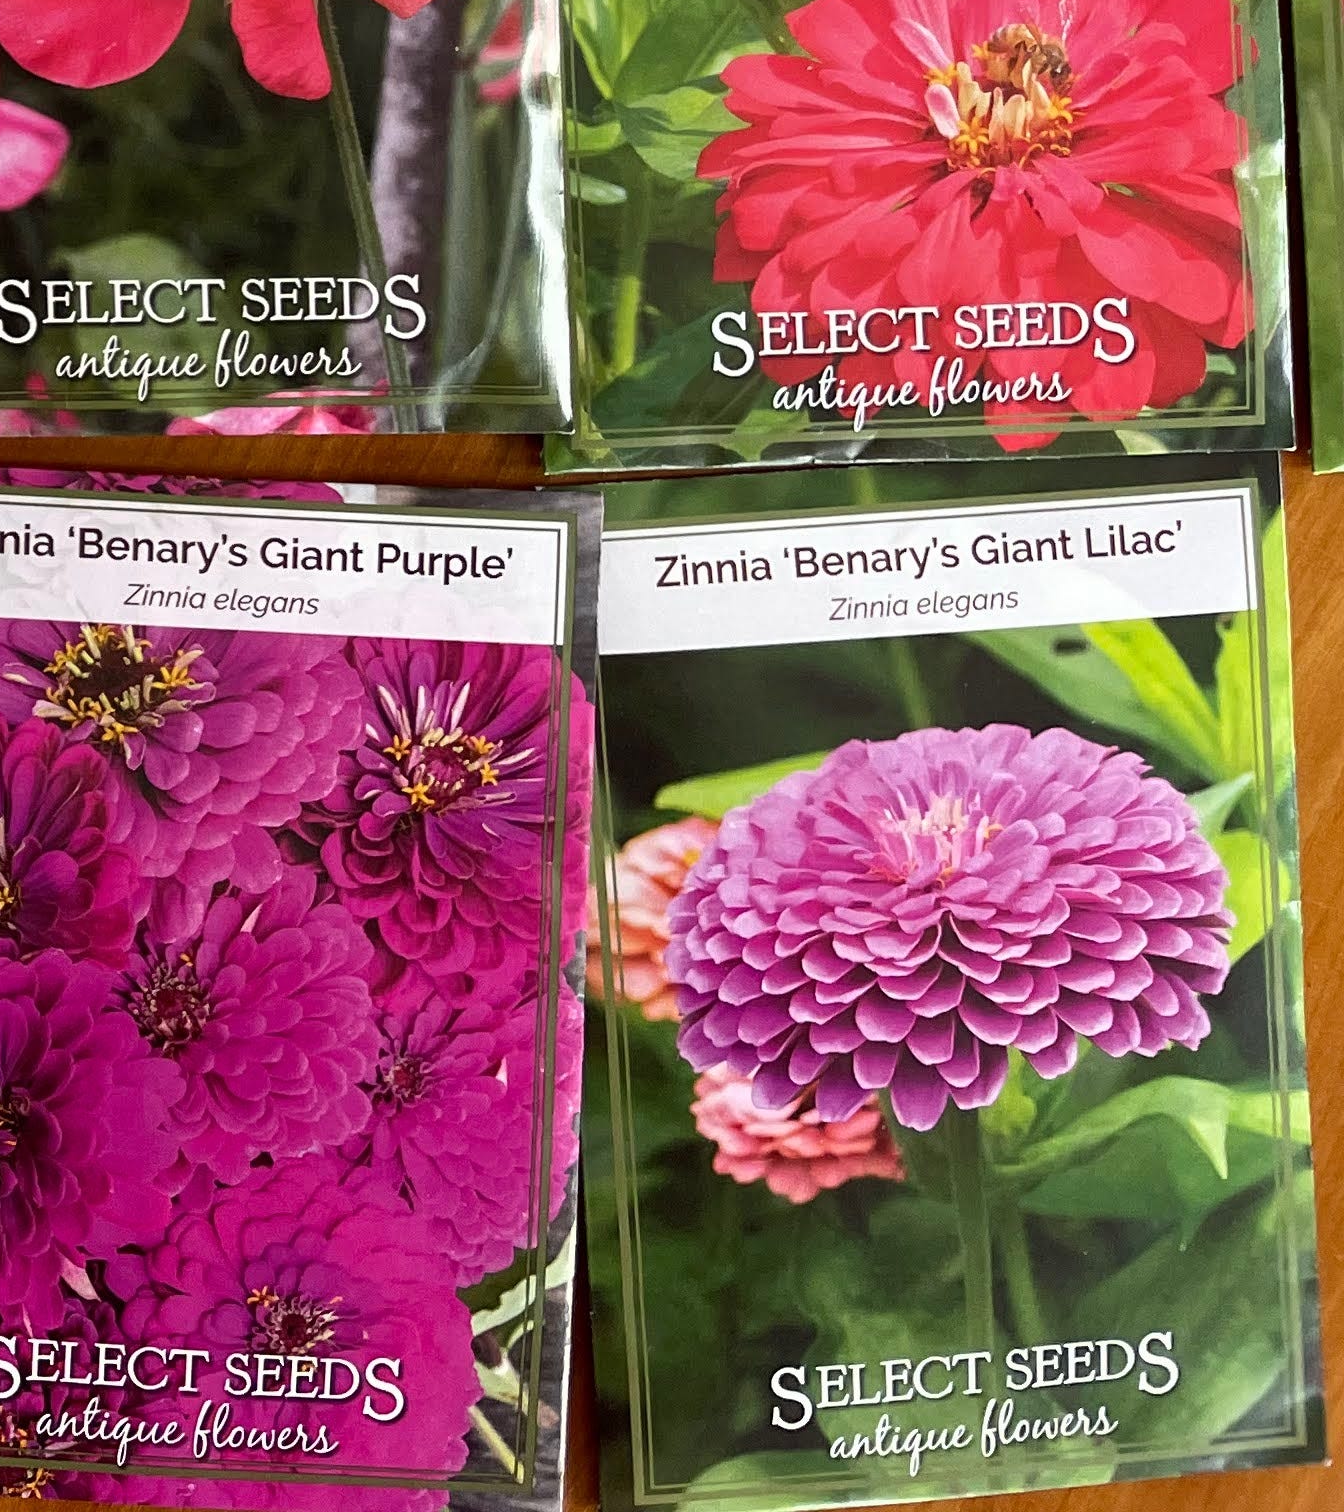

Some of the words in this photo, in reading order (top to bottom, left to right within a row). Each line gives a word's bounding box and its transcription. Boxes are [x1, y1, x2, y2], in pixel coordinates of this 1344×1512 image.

[242, 274, 426, 339] SEEDS
[712, 311, 939, 377] SELECT
[954, 297, 1134, 364] SEEDS
[56, 335, 205, 401] antique
[215, 329, 362, 387] flowers
[772, 366, 920, 430] antique
[929, 356, 1072, 416] flowers
[68, 527, 249, 574] ‘Benary’s
[259, 538, 364, 574] Giant
[377, 542, 512, 586] Purple’
[655, 553, 772, 588] Zinnia
[784, 538, 959, 579] ‘Benary’s
[971, 529, 1074, 565] Giant
[1086, 522, 1182, 559] Lilac’
[123, 583, 206, 610] Zinnia
[213, 588, 320, 616] elegans
[829, 595, 909, 621] Zinnia
[916, 589, 1019, 617] elegans
[224, 1353, 404, 1421] SEEDS
[770, 1351, 991, 1429] SELECT
[1006, 1332, 1179, 1395] SEEDS
[36, 1397, 185, 1466] antique
[193, 1400, 338, 1458] flowers
[830, 1414, 973, 1478] antique
[980, 1399, 1118, 1457] flowers
